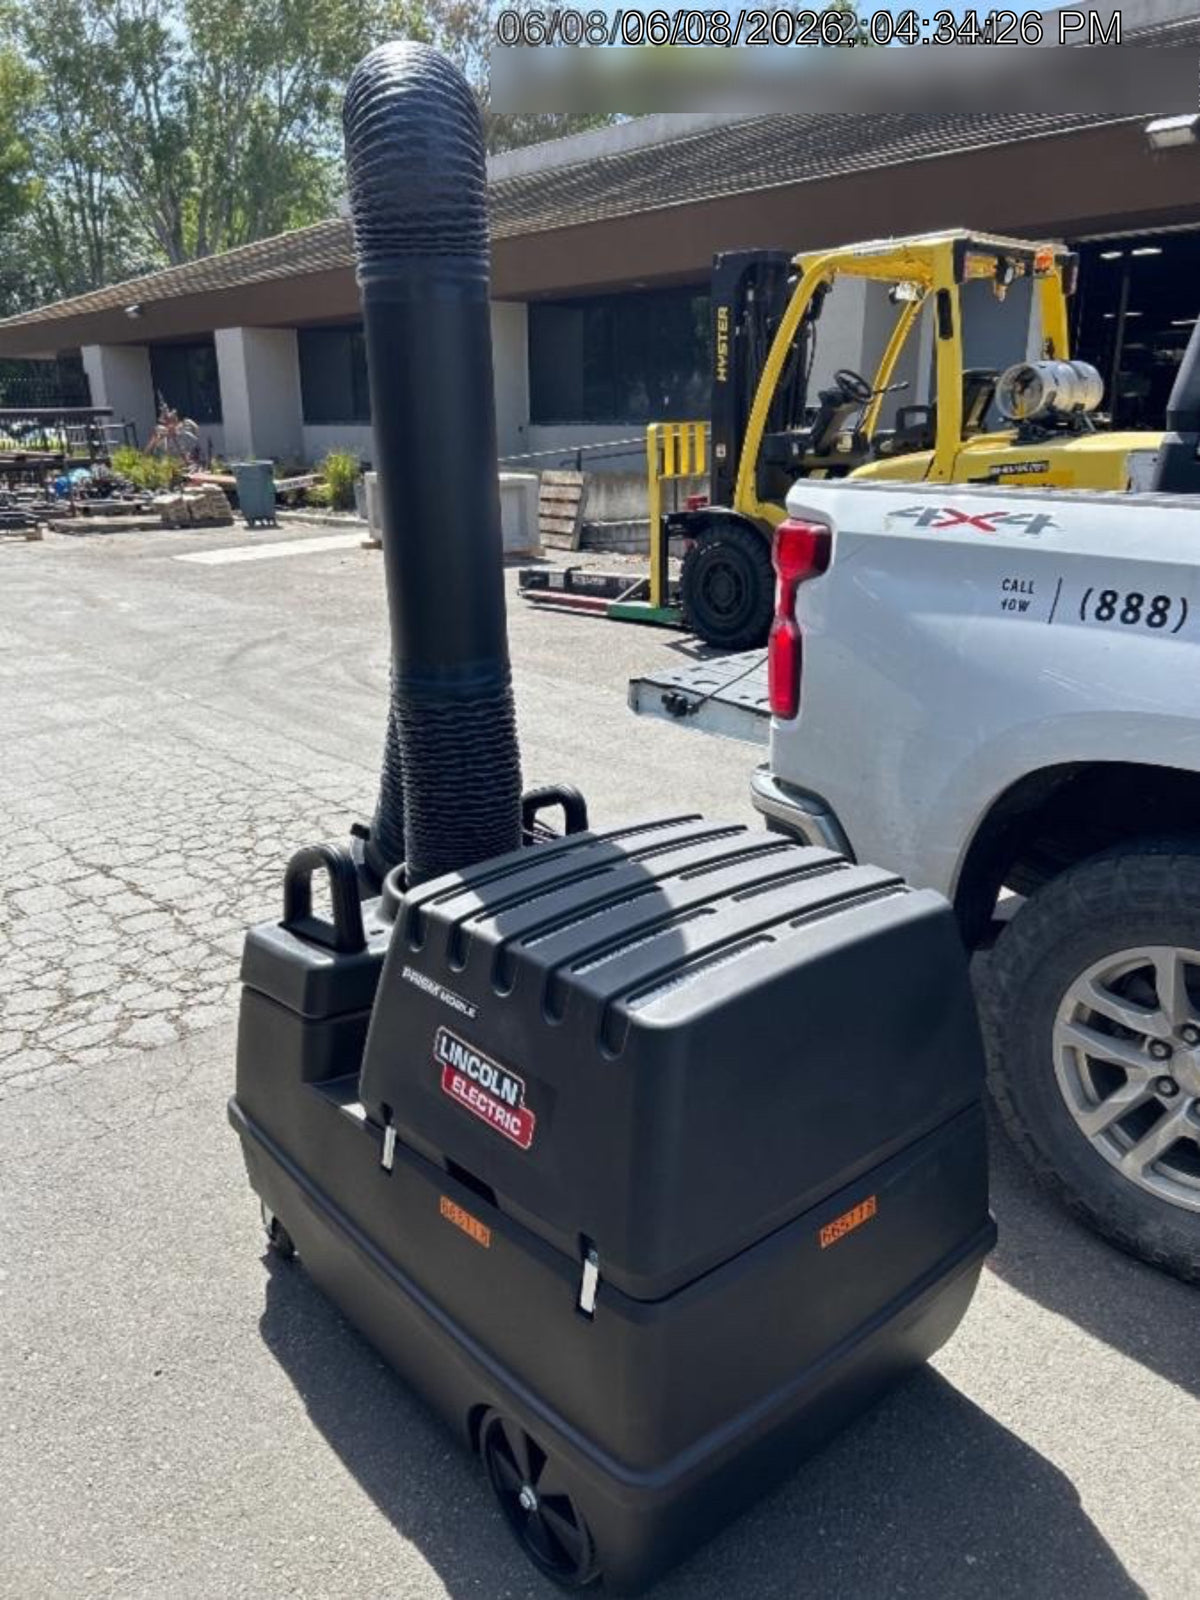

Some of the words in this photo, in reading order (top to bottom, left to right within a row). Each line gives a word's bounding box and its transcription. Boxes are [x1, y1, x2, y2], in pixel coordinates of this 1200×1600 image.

[716, 306, 729, 382] HYSTER
[1001, 578, 1034, 594] CALL
[1080, 587, 1187, 633] (888)
[440, 1035, 519, 1106] LINCOLN
[452, 1074, 522, 1136] ELECTRIC
